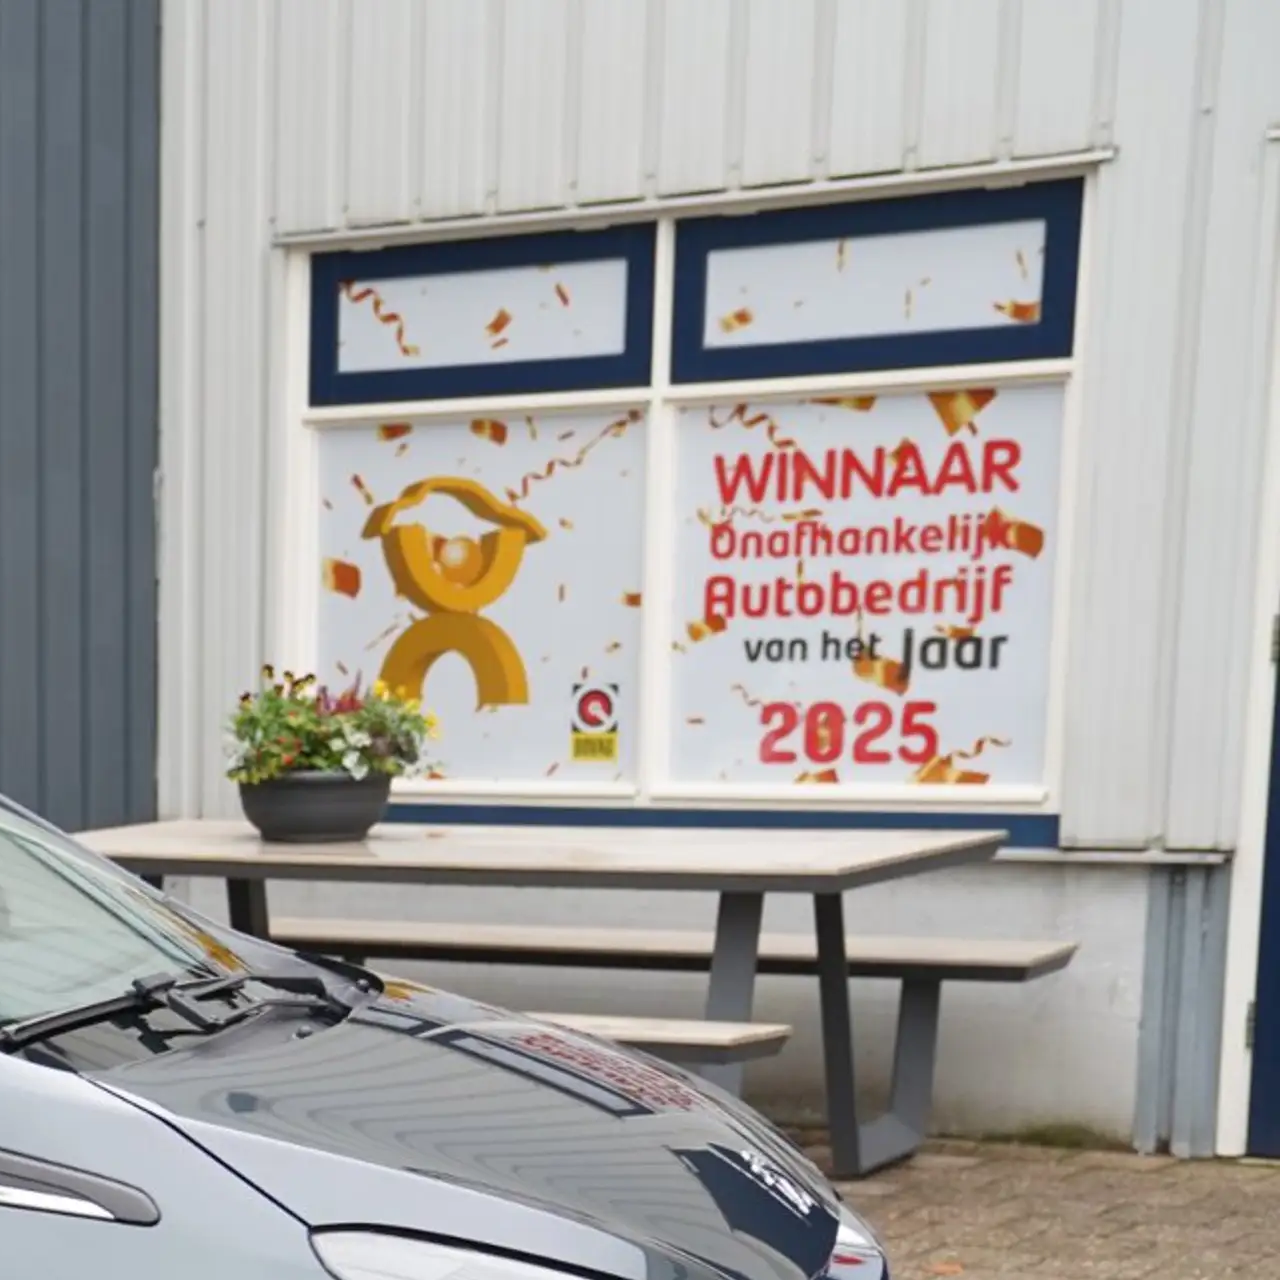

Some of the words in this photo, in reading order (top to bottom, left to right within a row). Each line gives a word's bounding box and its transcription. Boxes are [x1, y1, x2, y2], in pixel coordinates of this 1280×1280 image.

[713, 440, 1022, 504] WINNAAR
[710, 513, 1012, 562] Onafhankelijk
[704, 564, 1014, 625] Autobedrijf
[744, 636, 809, 663] van
[821, 630, 884, 663] het
[759, 700, 940, 765] 2025
